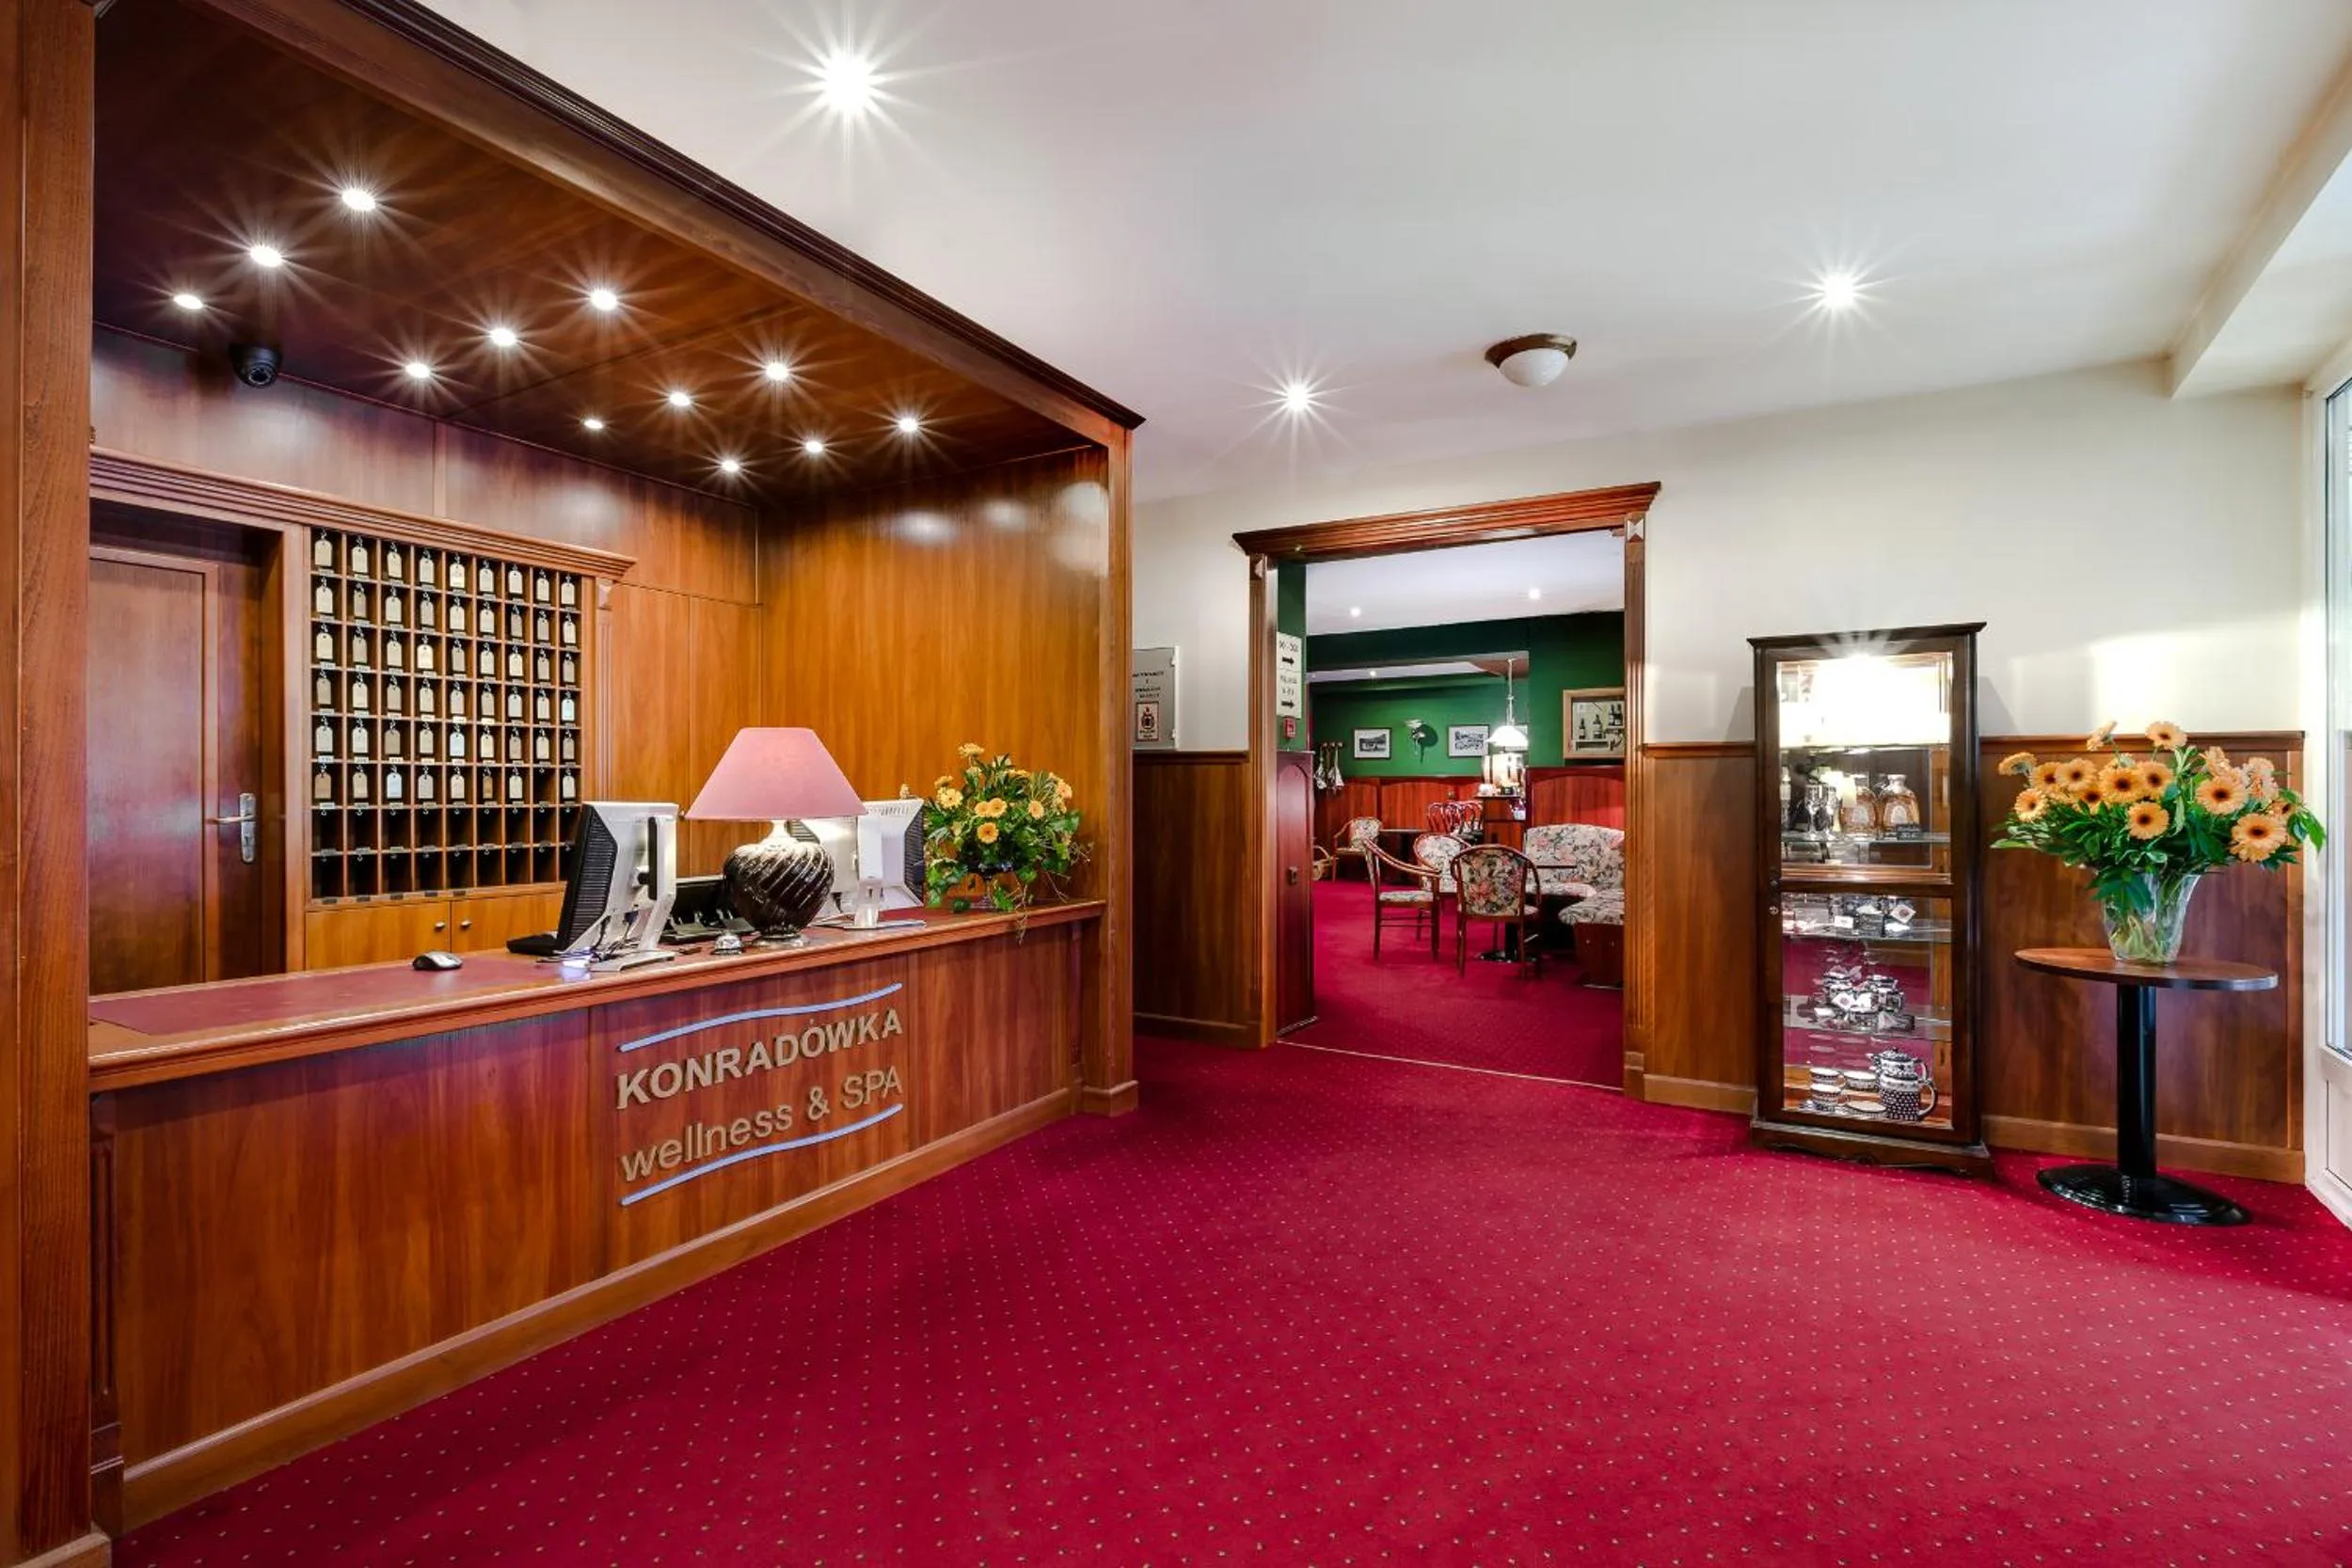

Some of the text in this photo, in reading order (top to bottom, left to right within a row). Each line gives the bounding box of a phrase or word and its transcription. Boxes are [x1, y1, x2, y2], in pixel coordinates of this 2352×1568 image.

[621, 1066, 903, 1181] wellness & SPA
